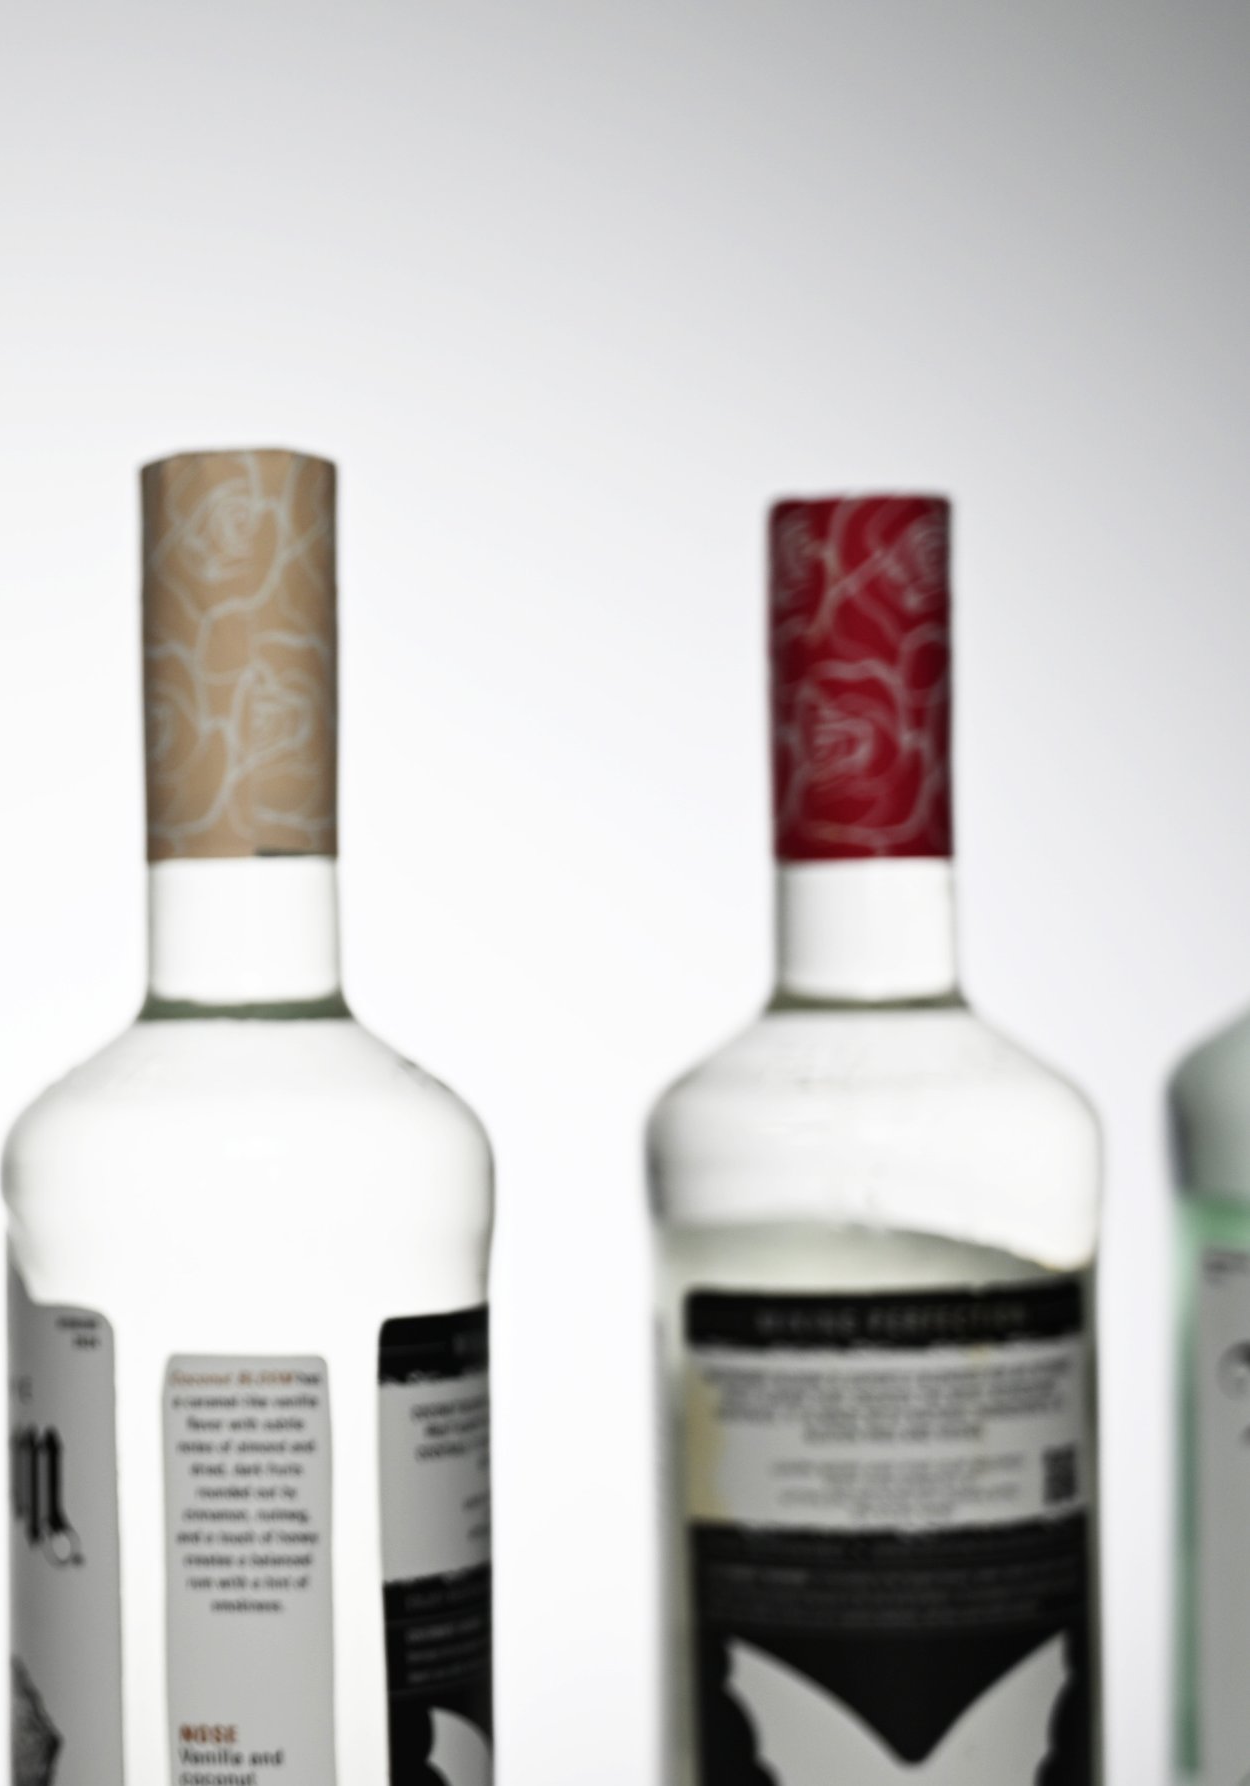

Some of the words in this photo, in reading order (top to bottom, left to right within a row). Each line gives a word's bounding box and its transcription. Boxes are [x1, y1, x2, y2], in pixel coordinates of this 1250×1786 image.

[228, 1416, 258, 1432] with
[219, 1438, 231, 1454] of
[237, 1439, 286, 1454] almond
[291, 1438, 316, 1454] and
[198, 1485, 250, 1500] rounded
[256, 1486, 276, 1500] out
[281, 1485, 298, 1502] by
[176, 1531, 201, 1546] and
[261, 1530, 273, 1546] of
[278, 1531, 319, 1548] honey
[184, 1555, 233, 1568] creates
[251, 1553, 313, 1569] balanced
[218, 1576, 247, 1591] with
[295, 1575, 309, 1591] of
[179, 1723, 238, 1744] NOSE
[179, 1749, 243, 1766] Vanilla
[250, 1749, 284, 1766] and
